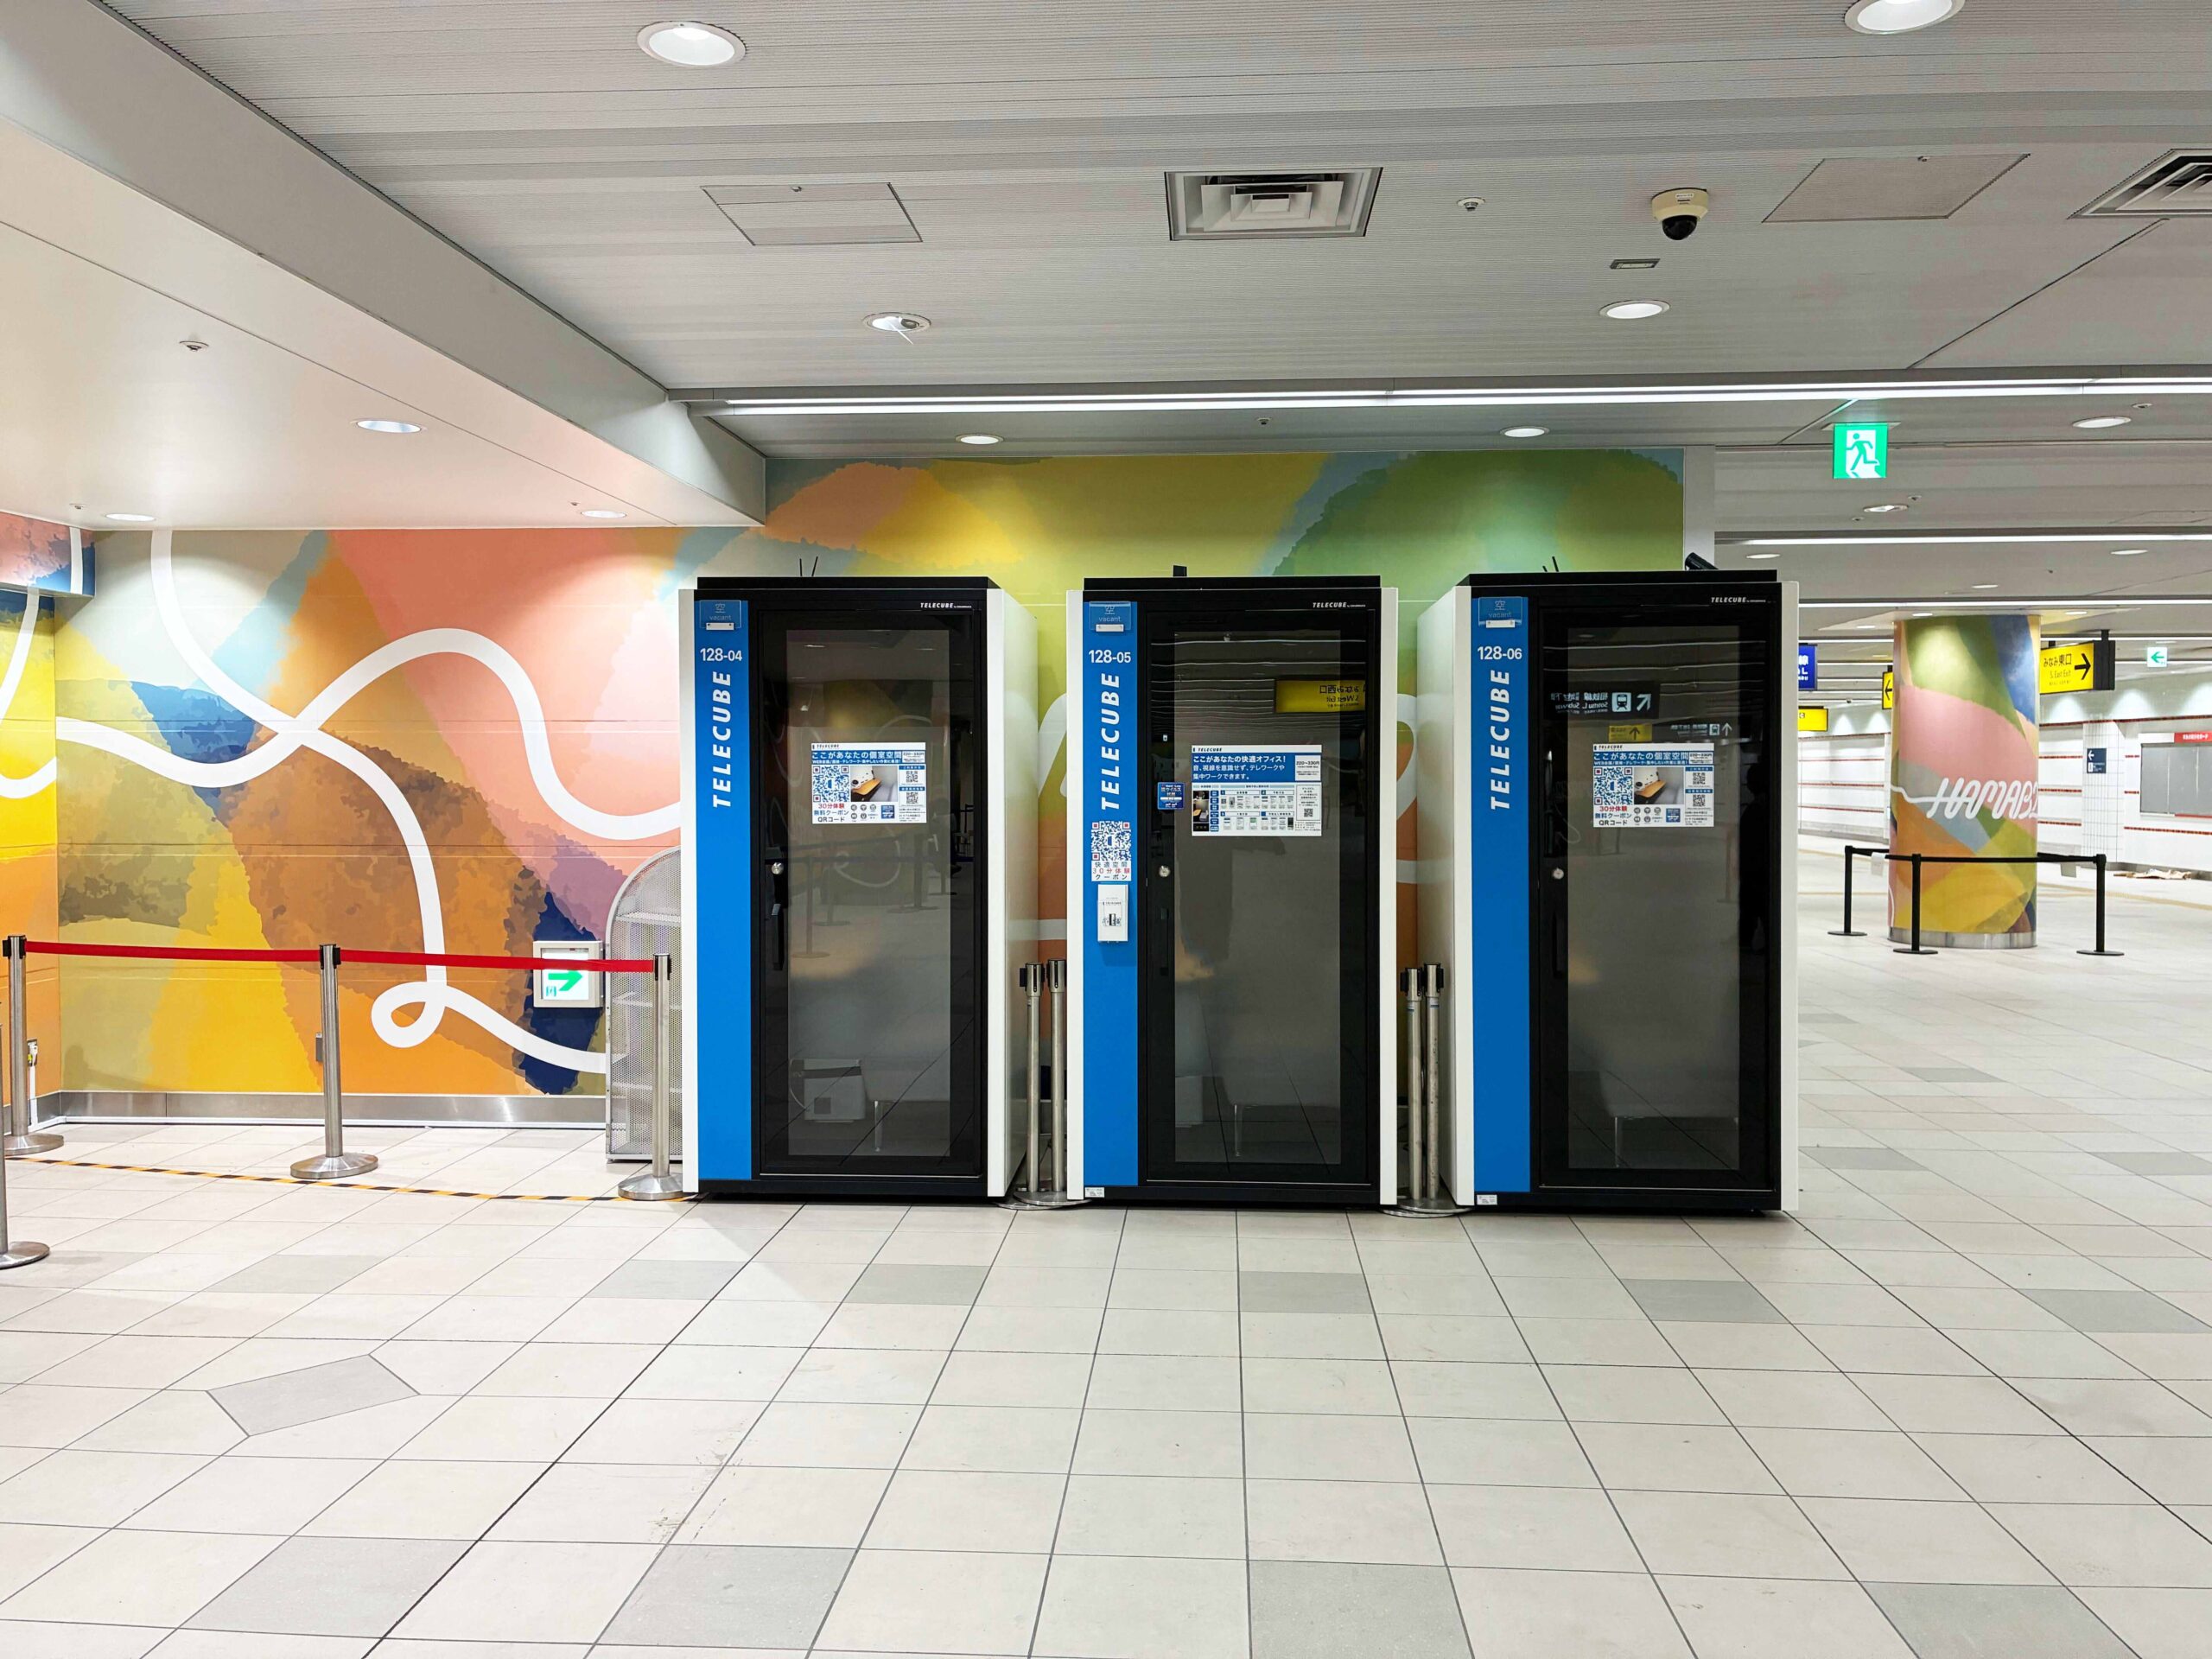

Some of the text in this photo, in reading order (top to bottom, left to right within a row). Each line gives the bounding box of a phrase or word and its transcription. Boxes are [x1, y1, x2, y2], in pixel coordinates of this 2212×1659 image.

[715, 603, 726, 613] 空
[1495, 601, 1506, 611] 空
[700, 647, 743, 662] 128-04
[1088, 649, 1131, 664] 128-05
[1478, 645, 1522, 660] 128-06
[712, 671, 731, 807] TELECUBE
[1101, 673, 1120, 810] TELECUBE
[1491, 670, 1510, 810] TELECUBE
[1593, 752, 1689, 760] ここがあなたの個室空間
